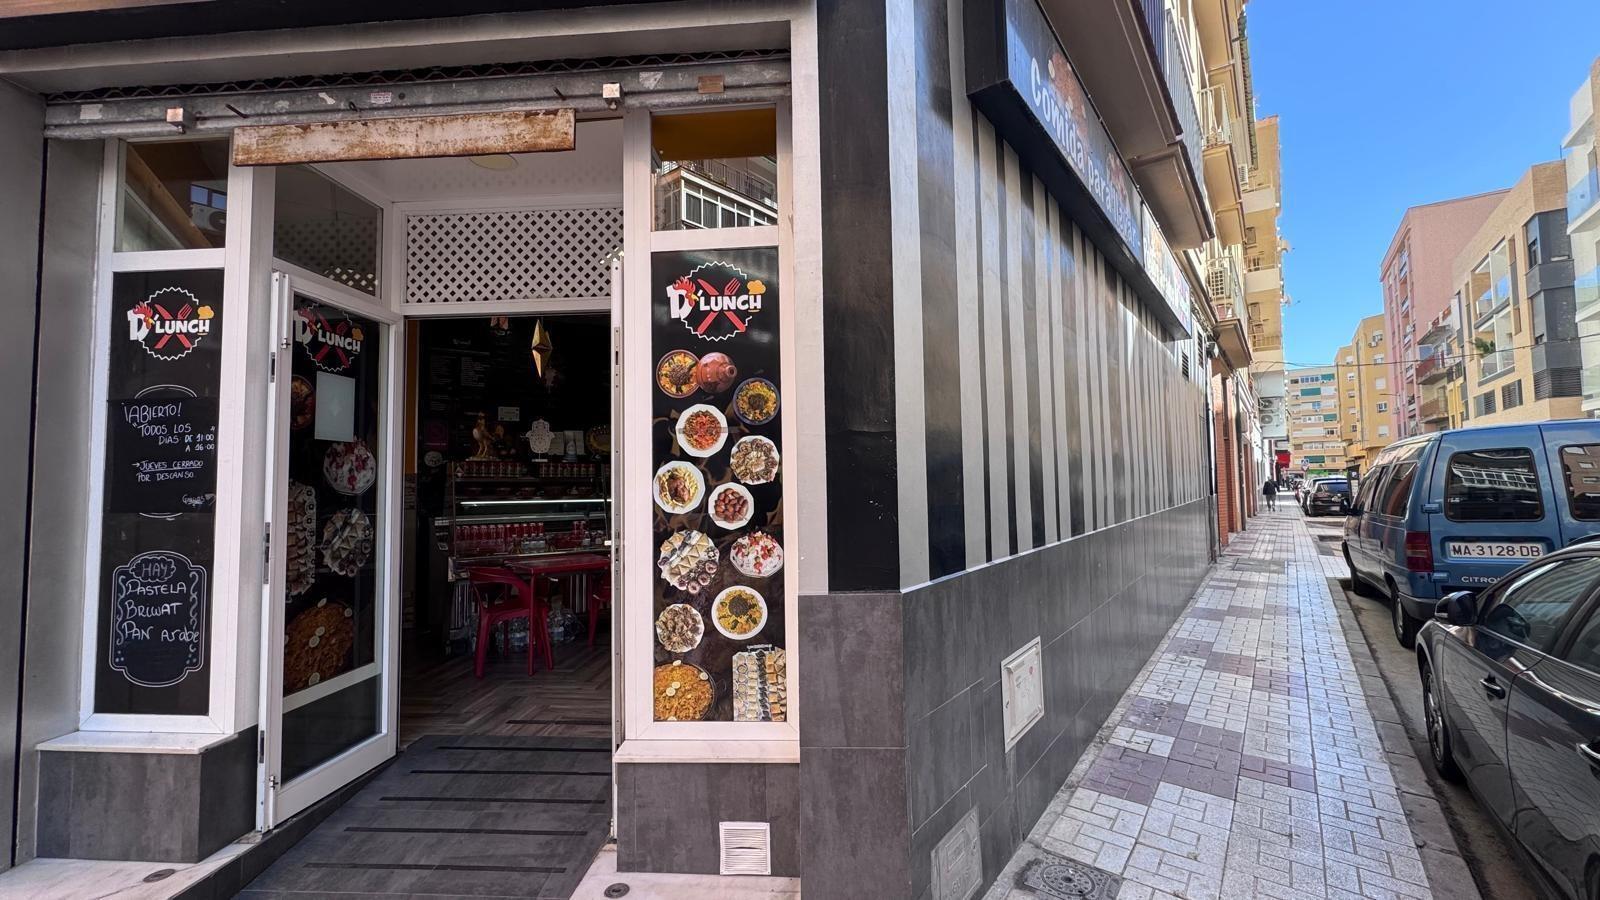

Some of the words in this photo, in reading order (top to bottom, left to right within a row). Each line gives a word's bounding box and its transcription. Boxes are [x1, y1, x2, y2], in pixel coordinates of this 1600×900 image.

[1031, 57, 1085, 173] Comida
[1087, 155, 1112, 213] para
[121, 402, 182, 424] ¡ABIERTO!
[137, 423, 168, 437] TODOS
[174, 423, 192, 434] LOS
[185, 444, 191, 453] A
[140, 460, 168, 471] JUEVES
[172, 460, 204, 469] CERRADO
[136, 471, 152, 482] POR
[156, 471, 195, 481] DESCANSO
[141, 562, 168, 578] HAY
[126, 579, 187, 595] PASTELA
